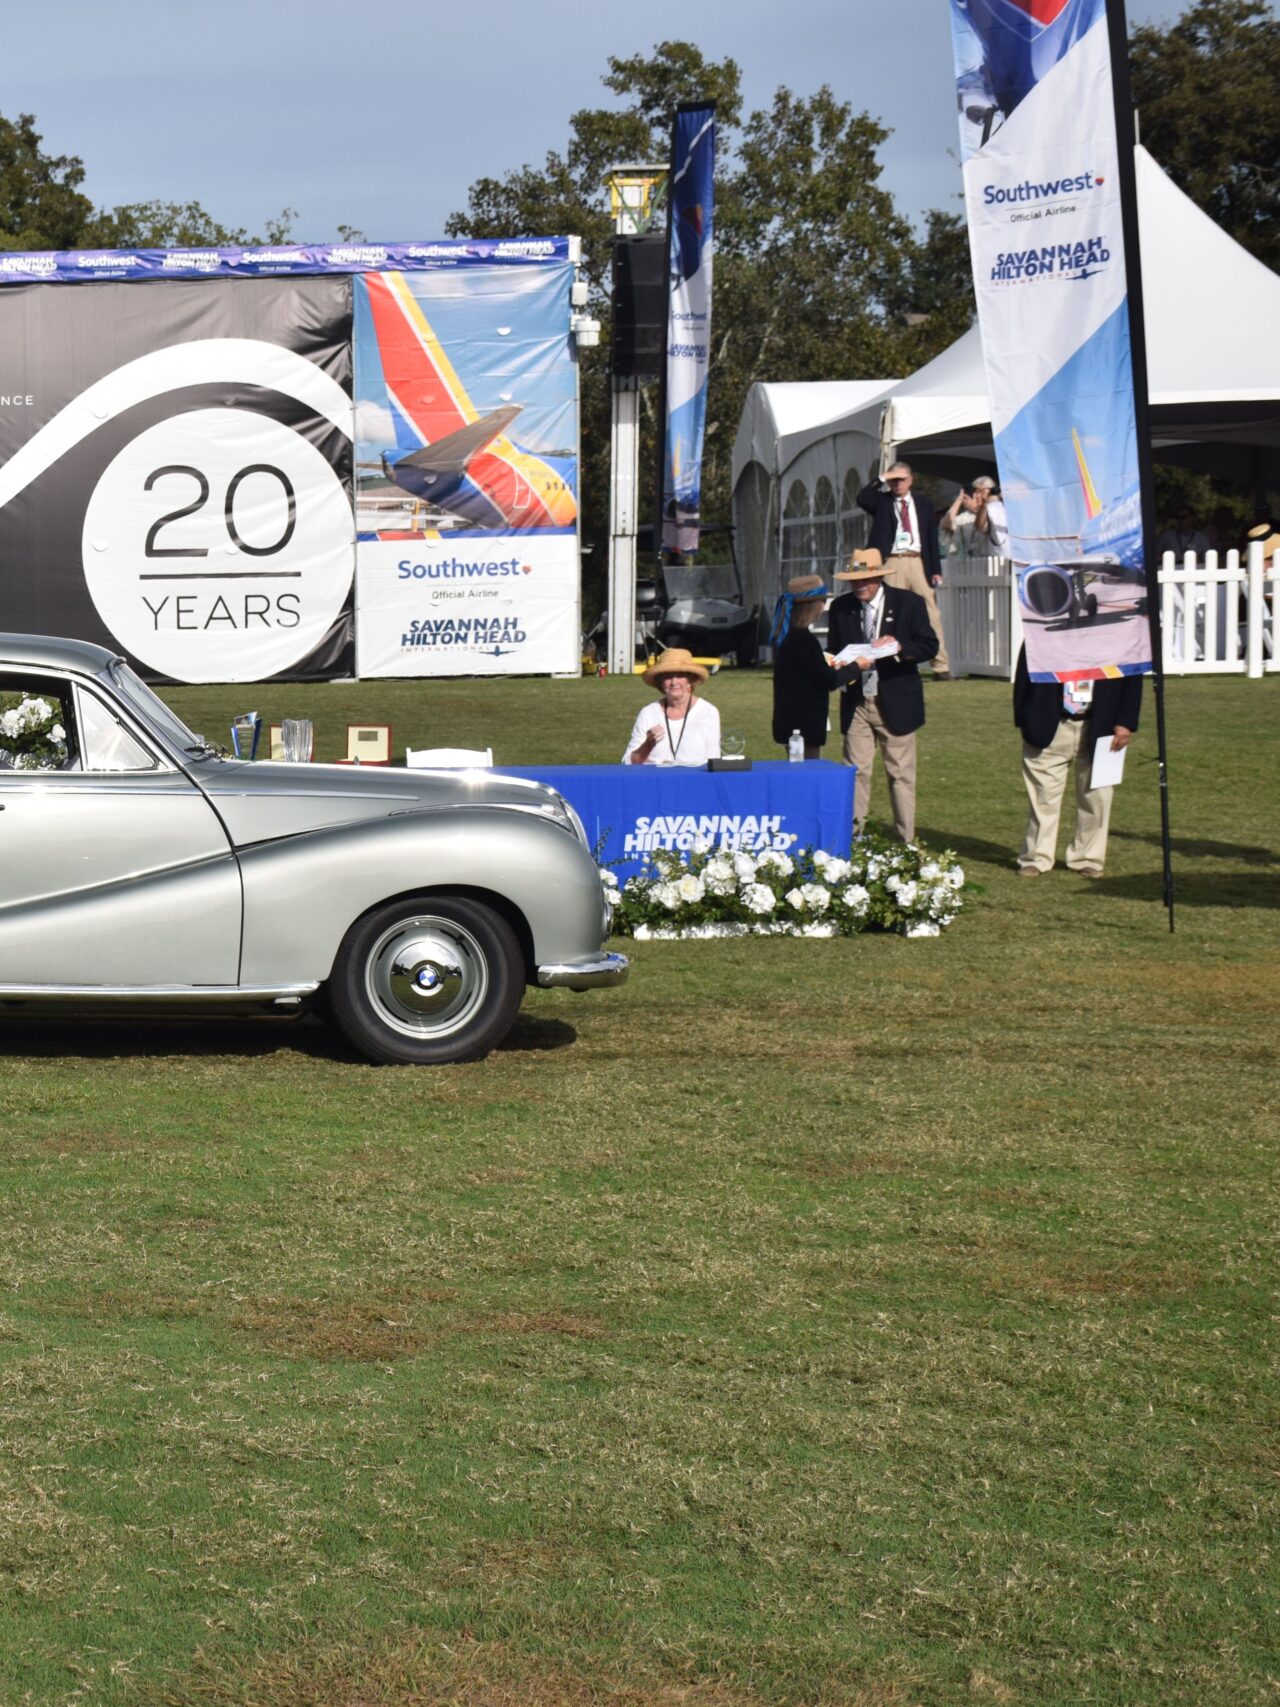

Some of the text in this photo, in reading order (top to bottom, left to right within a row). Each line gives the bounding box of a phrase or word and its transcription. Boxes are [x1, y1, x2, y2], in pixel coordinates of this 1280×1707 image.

[983, 172, 1093, 205] Southwest
[1010, 205, 1077, 223] Official Airline
[242, 251, 299, 264] Southwest
[408, 245, 467, 258] Southwest
[996, 236, 1103, 268] SAVANNAH
[78, 255, 136, 268] Southwest
[991, 248, 1111, 281] HILTON HEAD
[143, 463, 297, 558] 20
[397, 557, 521, 580] Southwest
[431, 589, 500, 600] Official Airline
[141, 593, 301, 631] YEARS
[409, 617, 519, 633] SAVANNAH
[400, 630, 527, 647] HILTON HEAD
[634, 815, 781, 834] SAVANNAH
[719, 832, 794, 852] HEAD
